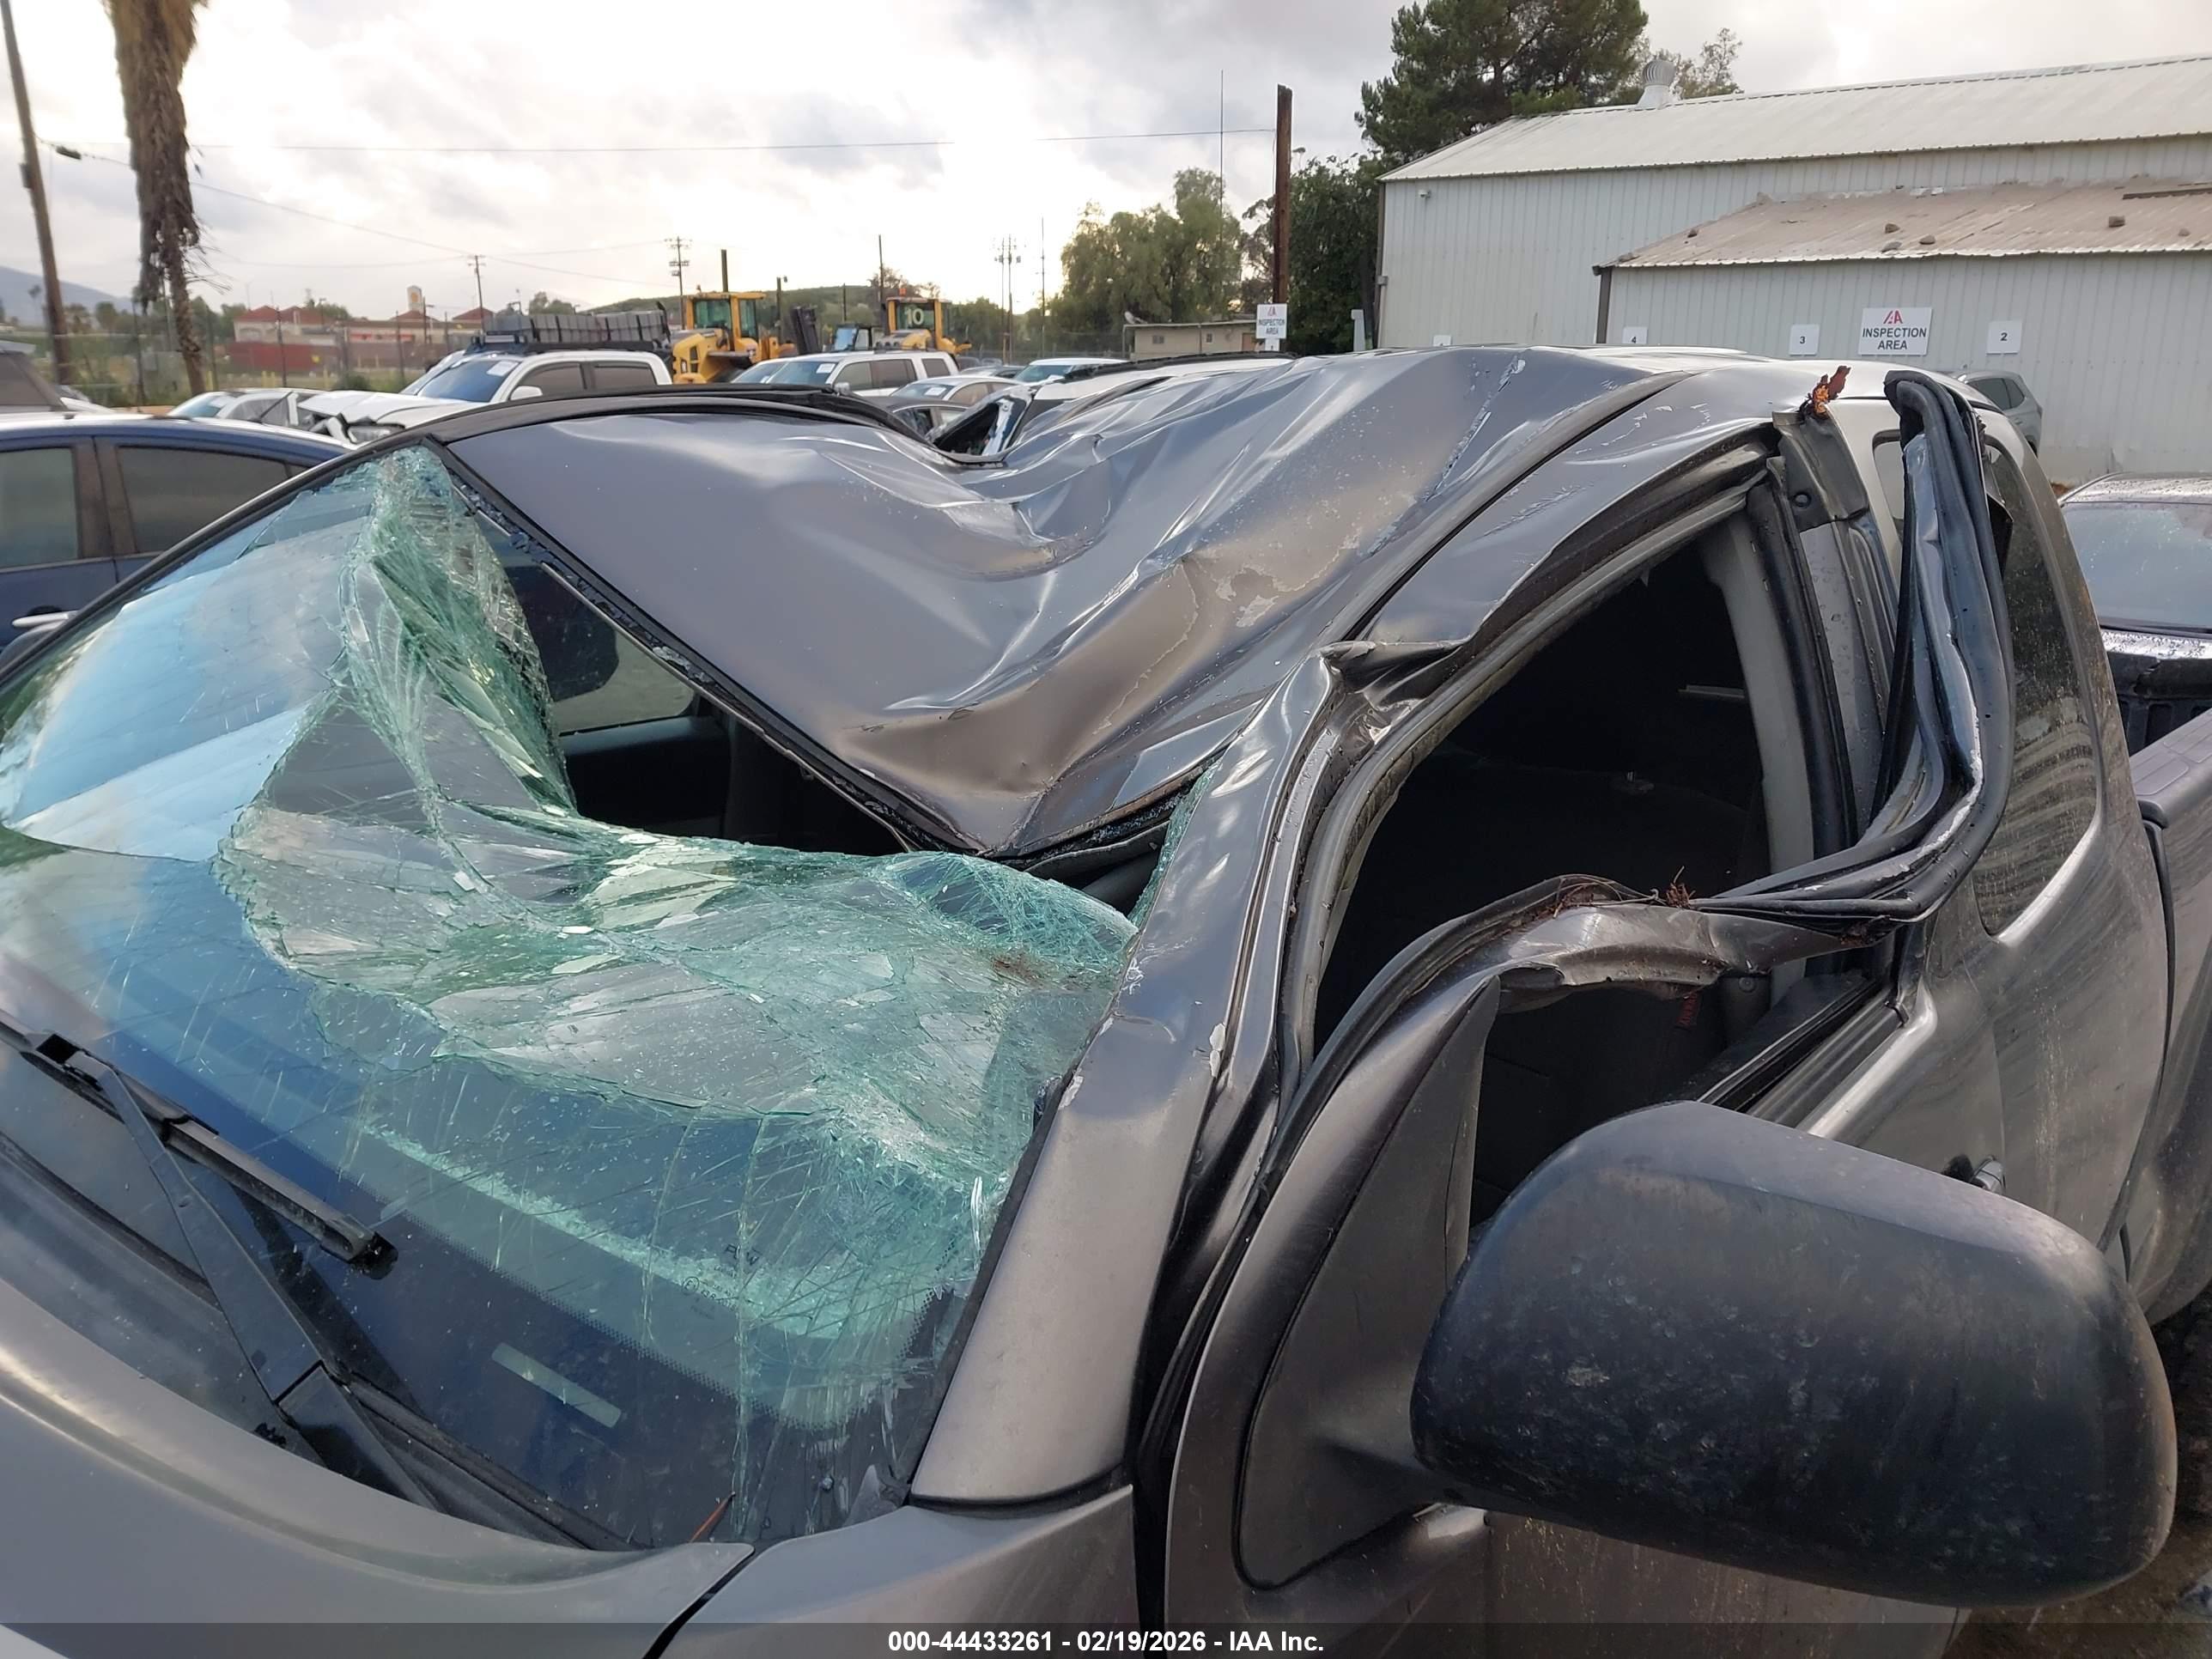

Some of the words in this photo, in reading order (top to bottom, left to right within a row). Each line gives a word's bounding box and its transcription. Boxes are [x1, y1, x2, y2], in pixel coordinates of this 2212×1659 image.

[904, 308, 925, 326] 10
[1862, 327, 1927, 338] INSPECTION
[2000, 331, 2008, 342] 2
[1631, 336, 1637, 344] 4
[1799, 336, 1806, 344] 3
[1876, 340, 1908, 350] AREA
